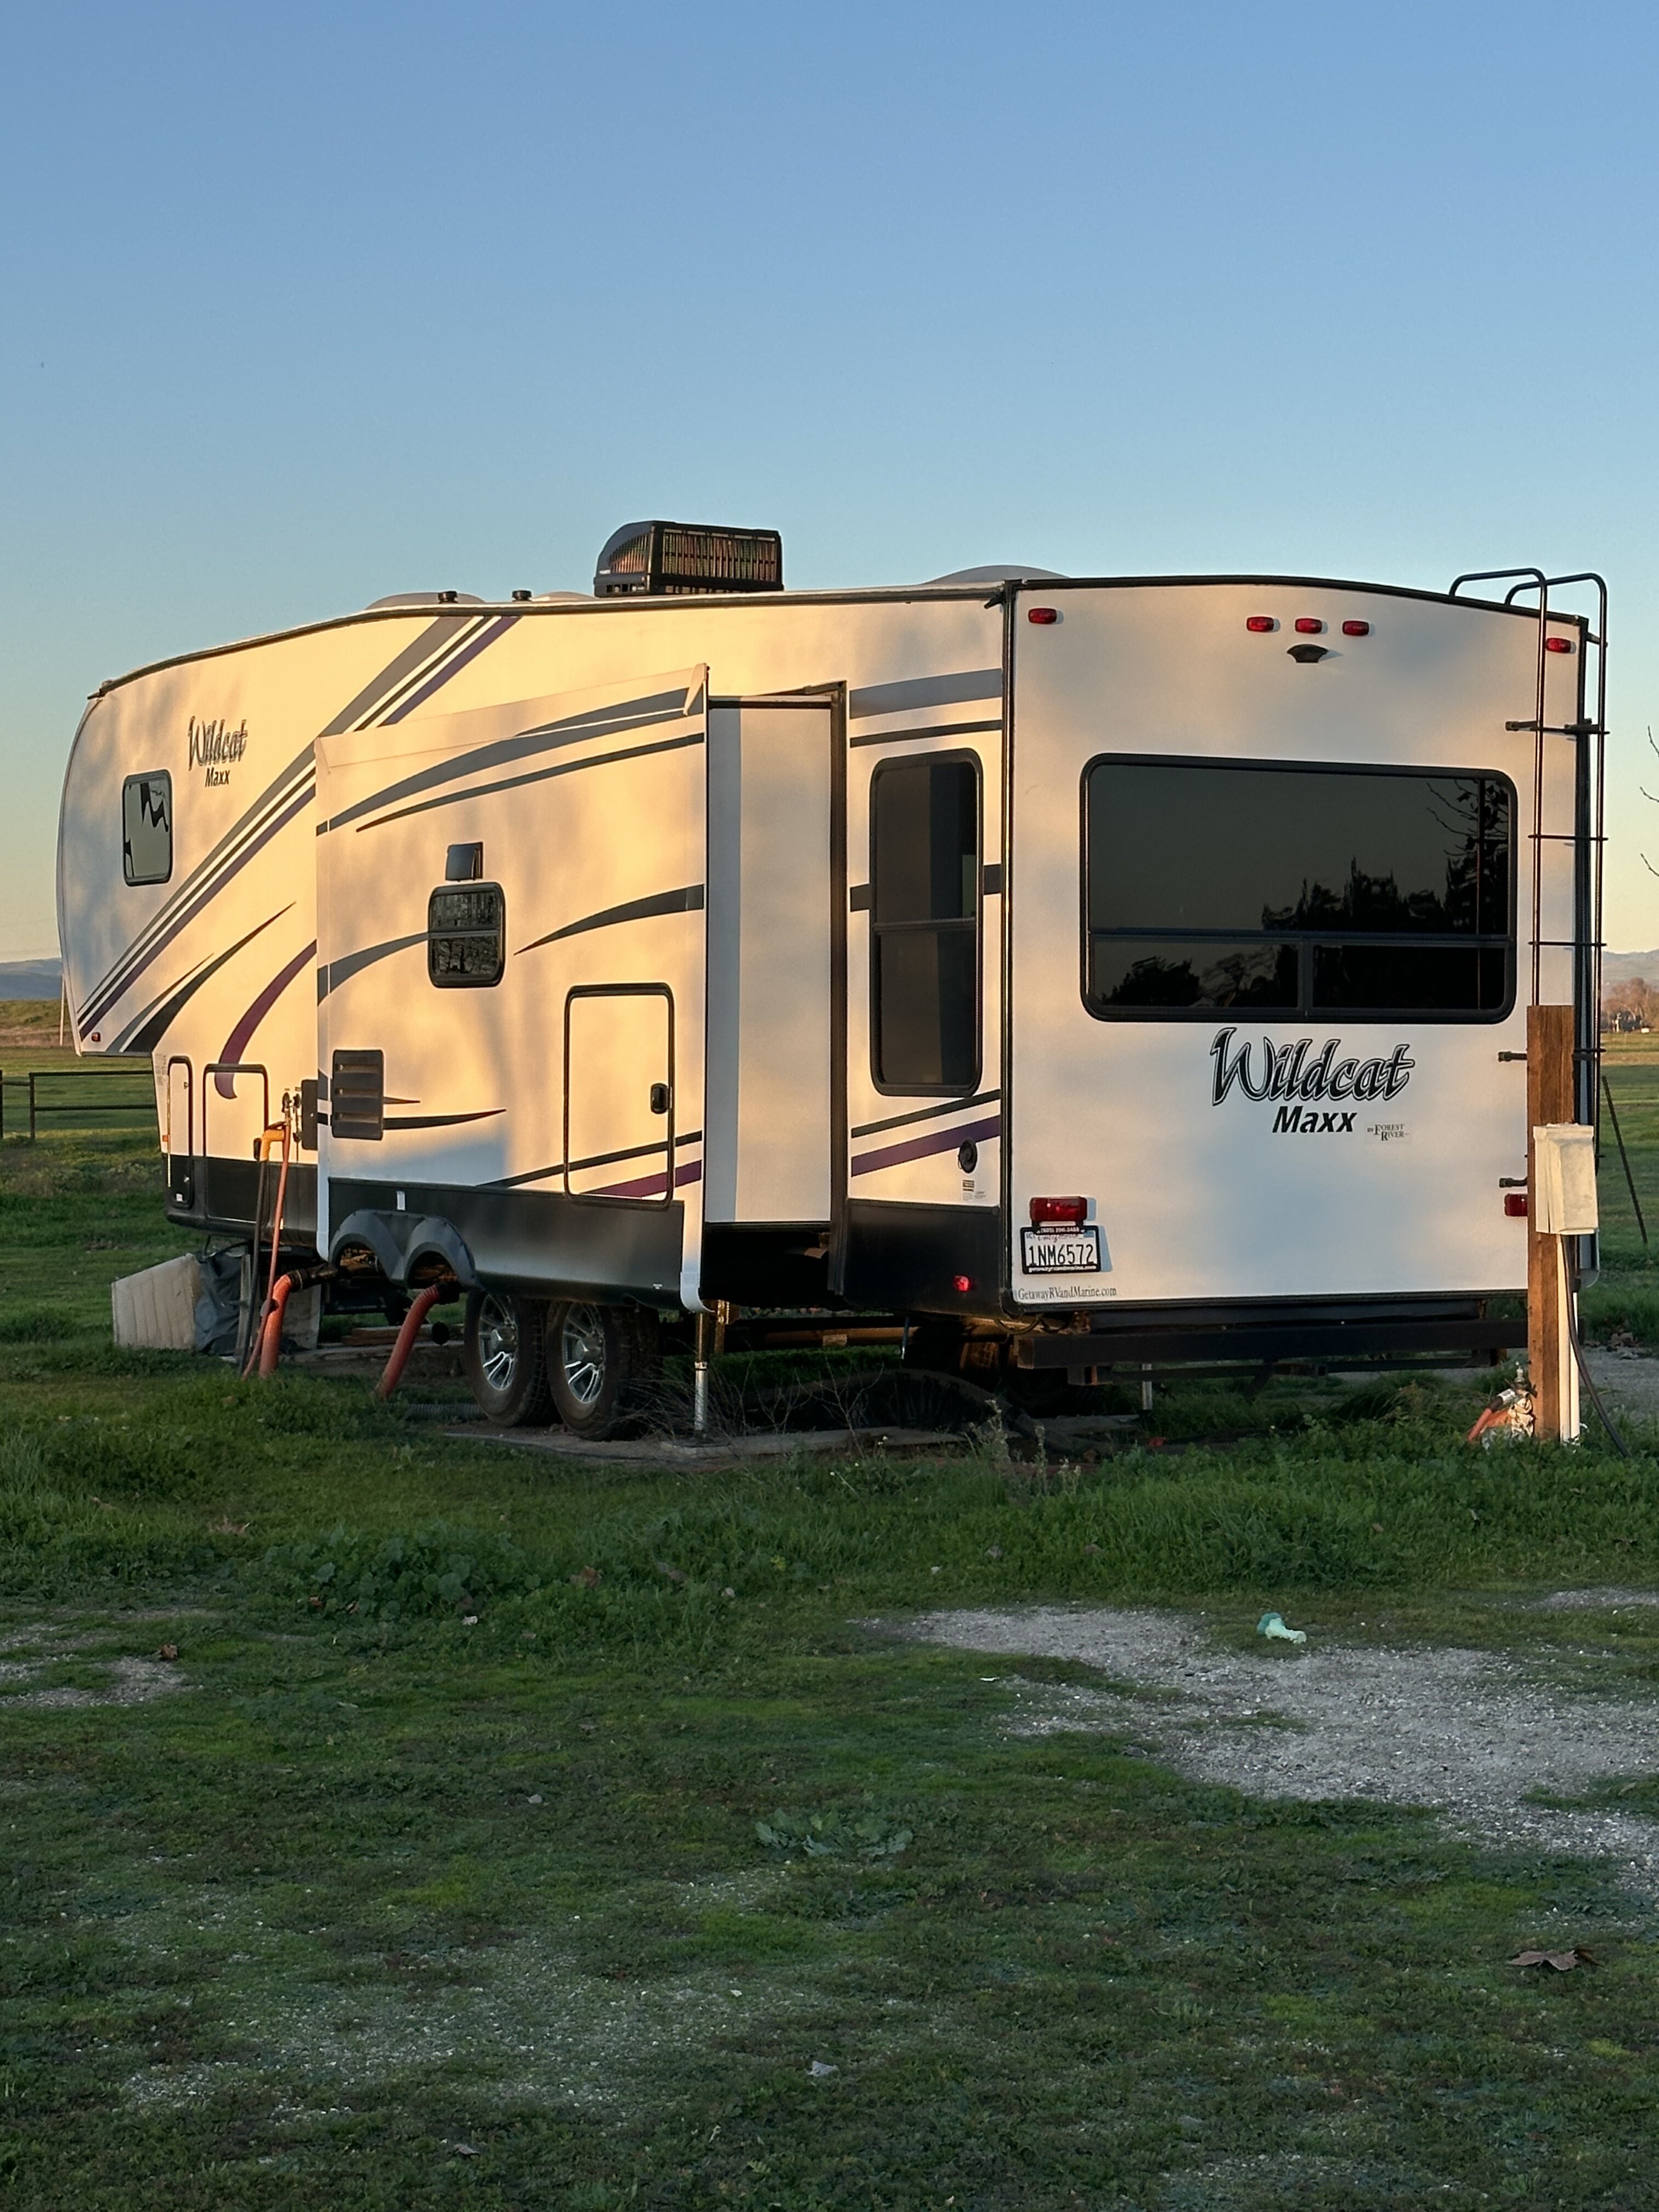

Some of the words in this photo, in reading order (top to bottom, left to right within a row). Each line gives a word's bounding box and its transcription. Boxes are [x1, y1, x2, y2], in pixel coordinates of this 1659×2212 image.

[188, 715, 248, 771] Wildcat
[205, 767, 230, 788] Maxx
[1210, 1027, 1415, 1106] Wildcat
[1272, 1105, 1357, 1133] Maxx
[1029, 1243, 1094, 1266] 1NM6572
[1018, 1285, 1118, 1301] GetawayRVandMarine.com
